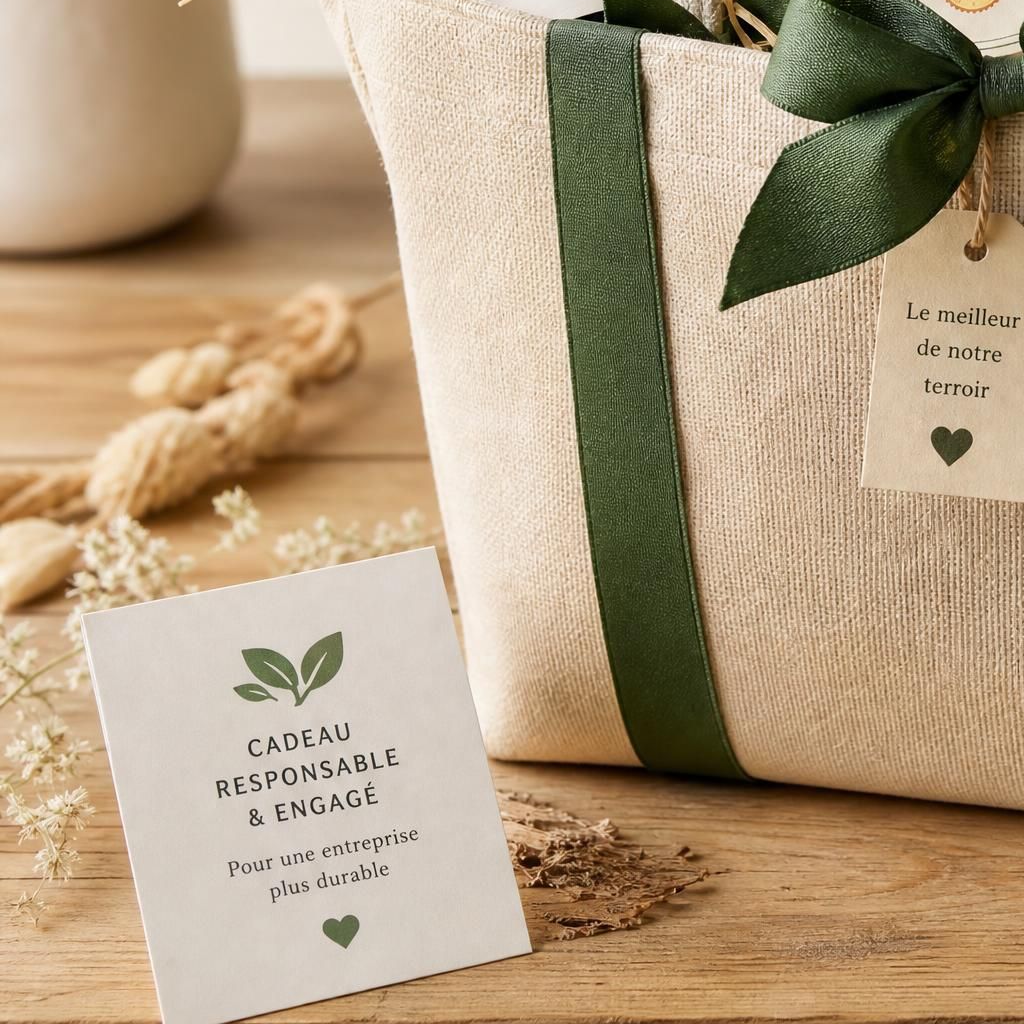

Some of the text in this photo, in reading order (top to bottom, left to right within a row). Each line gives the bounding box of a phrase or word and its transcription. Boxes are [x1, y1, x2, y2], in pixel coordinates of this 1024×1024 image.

[906, 302, 1021, 329] Le meilleur
[917, 339, 1003, 363] de notre
[924, 378, 990, 399] terroir
[247, 722, 352, 758] CADEAU
[216, 748, 400, 799] RESPONSABLE
[248, 782, 379, 827] & ENGAGÉ
[227, 828, 419, 878] Pour une entreprise
[269, 862, 390, 904] plus durable
